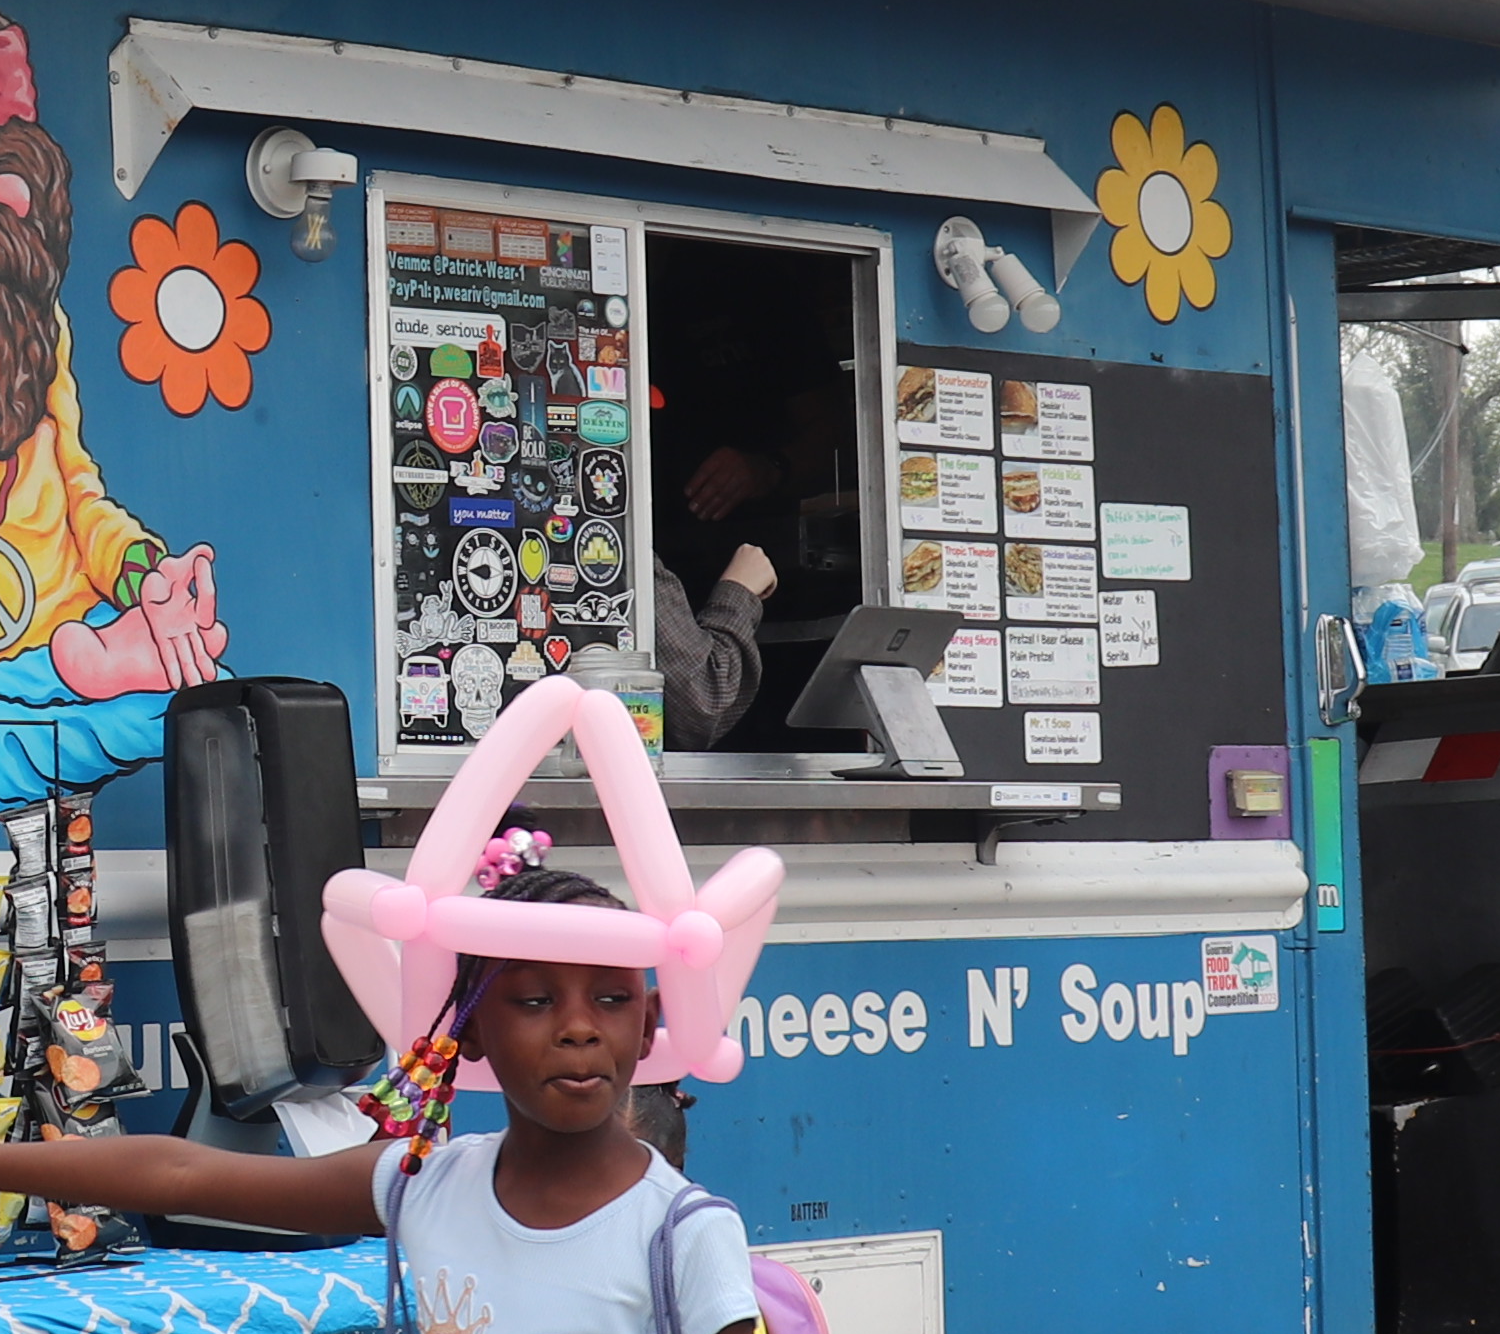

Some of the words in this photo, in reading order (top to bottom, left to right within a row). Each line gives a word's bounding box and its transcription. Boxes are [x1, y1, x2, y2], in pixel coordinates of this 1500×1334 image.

[388, 251, 430, 272] Venmo:
[540, 267, 590, 281] CINCINNATI
[540, 277, 566, 289] PUBLIC
[436, 322, 502, 341] seriousy
[1040, 387, 1053, 399] The
[1055, 389, 1082, 401] Classic
[582, 417, 624, 429] DESTIN
[522, 425, 534, 439] BE
[940, 459, 954, 469] The
[956, 459, 980, 471] Green
[453, 509, 474, 525] you
[476, 509, 512, 521] matter
[580, 525, 617, 547] MUNICIPAL
[458, 535, 480, 575] WEST
[489, 537, 514, 577] SIDE
[945, 546, 966, 557] Tropic
[968, 547, 996, 557] Thunder
[1102, 595, 1124, 605] Water
[1104, 613, 1122, 624] Coke
[950, 635, 974, 647] ersey
[975, 635, 998, 646] Shore
[1009, 633, 1034, 645] Pretzel
[1041, 635, 1058, 645] Beer
[1060, 635, 1084, 645] Cheese
[1105, 632, 1120, 643] Diet
[1122, 631, 1140, 643] Coke
[1010, 651, 1027, 661] Plain
[1028, 651, 1054, 662] Pretzel
[1106, 651, 1130, 664] Sprite
[1010, 669, 1030, 679] Chips
[1030, 718, 1044, 728] Mr.
[1052, 718, 1072, 731] Soup
[1206, 957, 1230, 974] FOOD
[1206, 975, 1238, 991] TRUCK
[1207, 991, 1260, 1009] Competition
[725, 988, 928, 1059] heese
[966, 966, 1030, 1049] N'
[1060, 962, 1208, 1057] Soup
